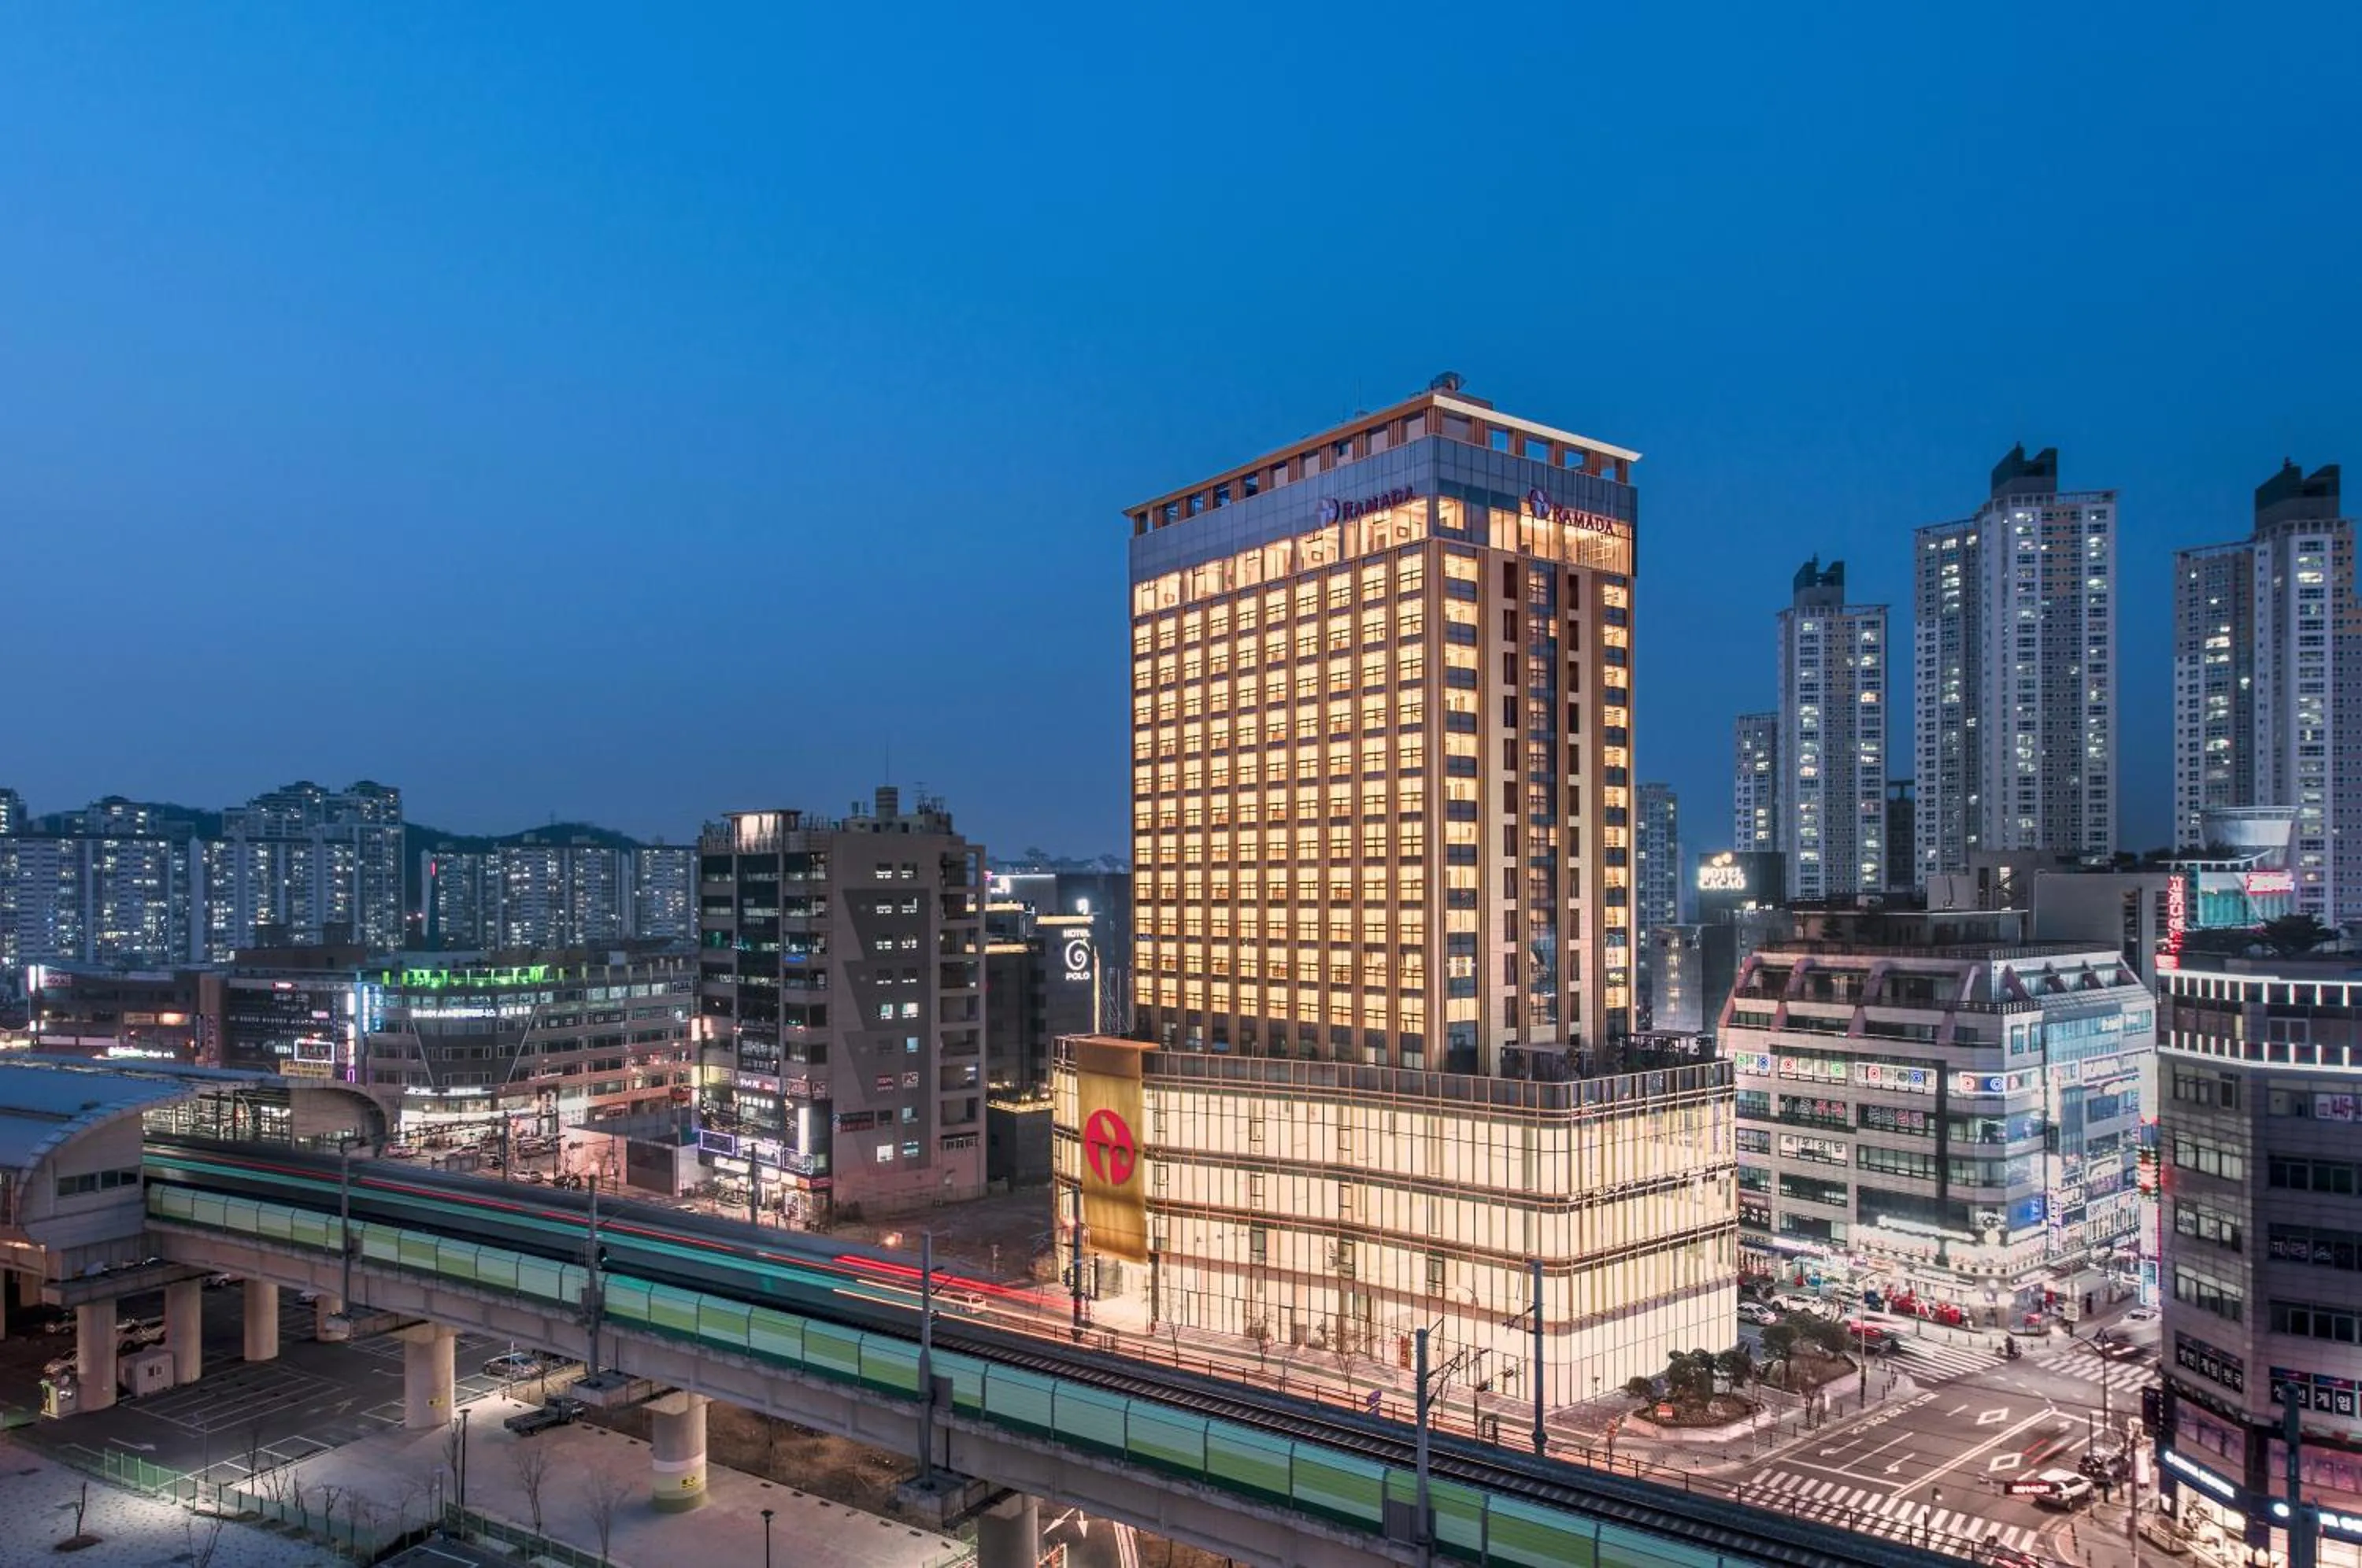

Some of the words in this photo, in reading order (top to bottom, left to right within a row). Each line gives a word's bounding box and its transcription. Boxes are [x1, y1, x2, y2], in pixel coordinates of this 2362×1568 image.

[1342, 486, 1412, 521] RAMADA
[1553, 504, 1613, 535] RAMADA
[1699, 867, 1744, 879] HOTEL
[1699, 878, 1746, 890] CACAO
[1063, 929, 1091, 938] HOTEL
[1066, 971, 1090, 982] POLO
